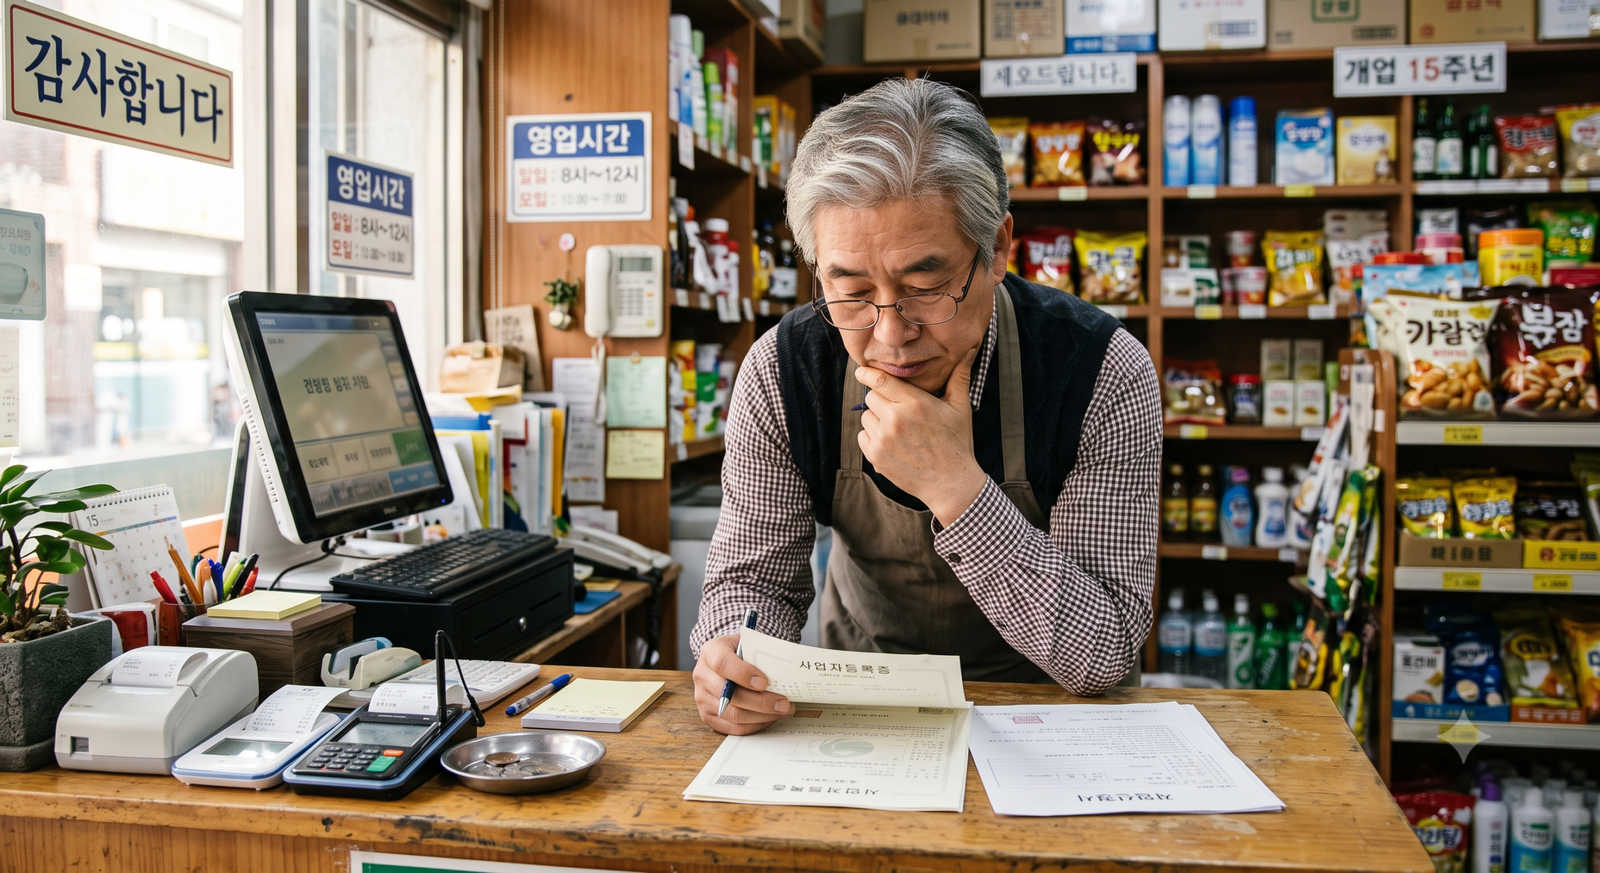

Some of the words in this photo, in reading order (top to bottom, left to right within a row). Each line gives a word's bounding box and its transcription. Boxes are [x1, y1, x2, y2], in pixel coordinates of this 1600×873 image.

[1344, 57, 1396, 85] 개업
[1409, 53, 1494, 83] 15주년
[25, 34, 223, 145] 감사합니다
[527, 122, 631, 156] 영업시간
[336, 164, 406, 211] 영업시간
[86, 514, 99, 528] 15
[799, 659, 891, 675] 사업자등록증
